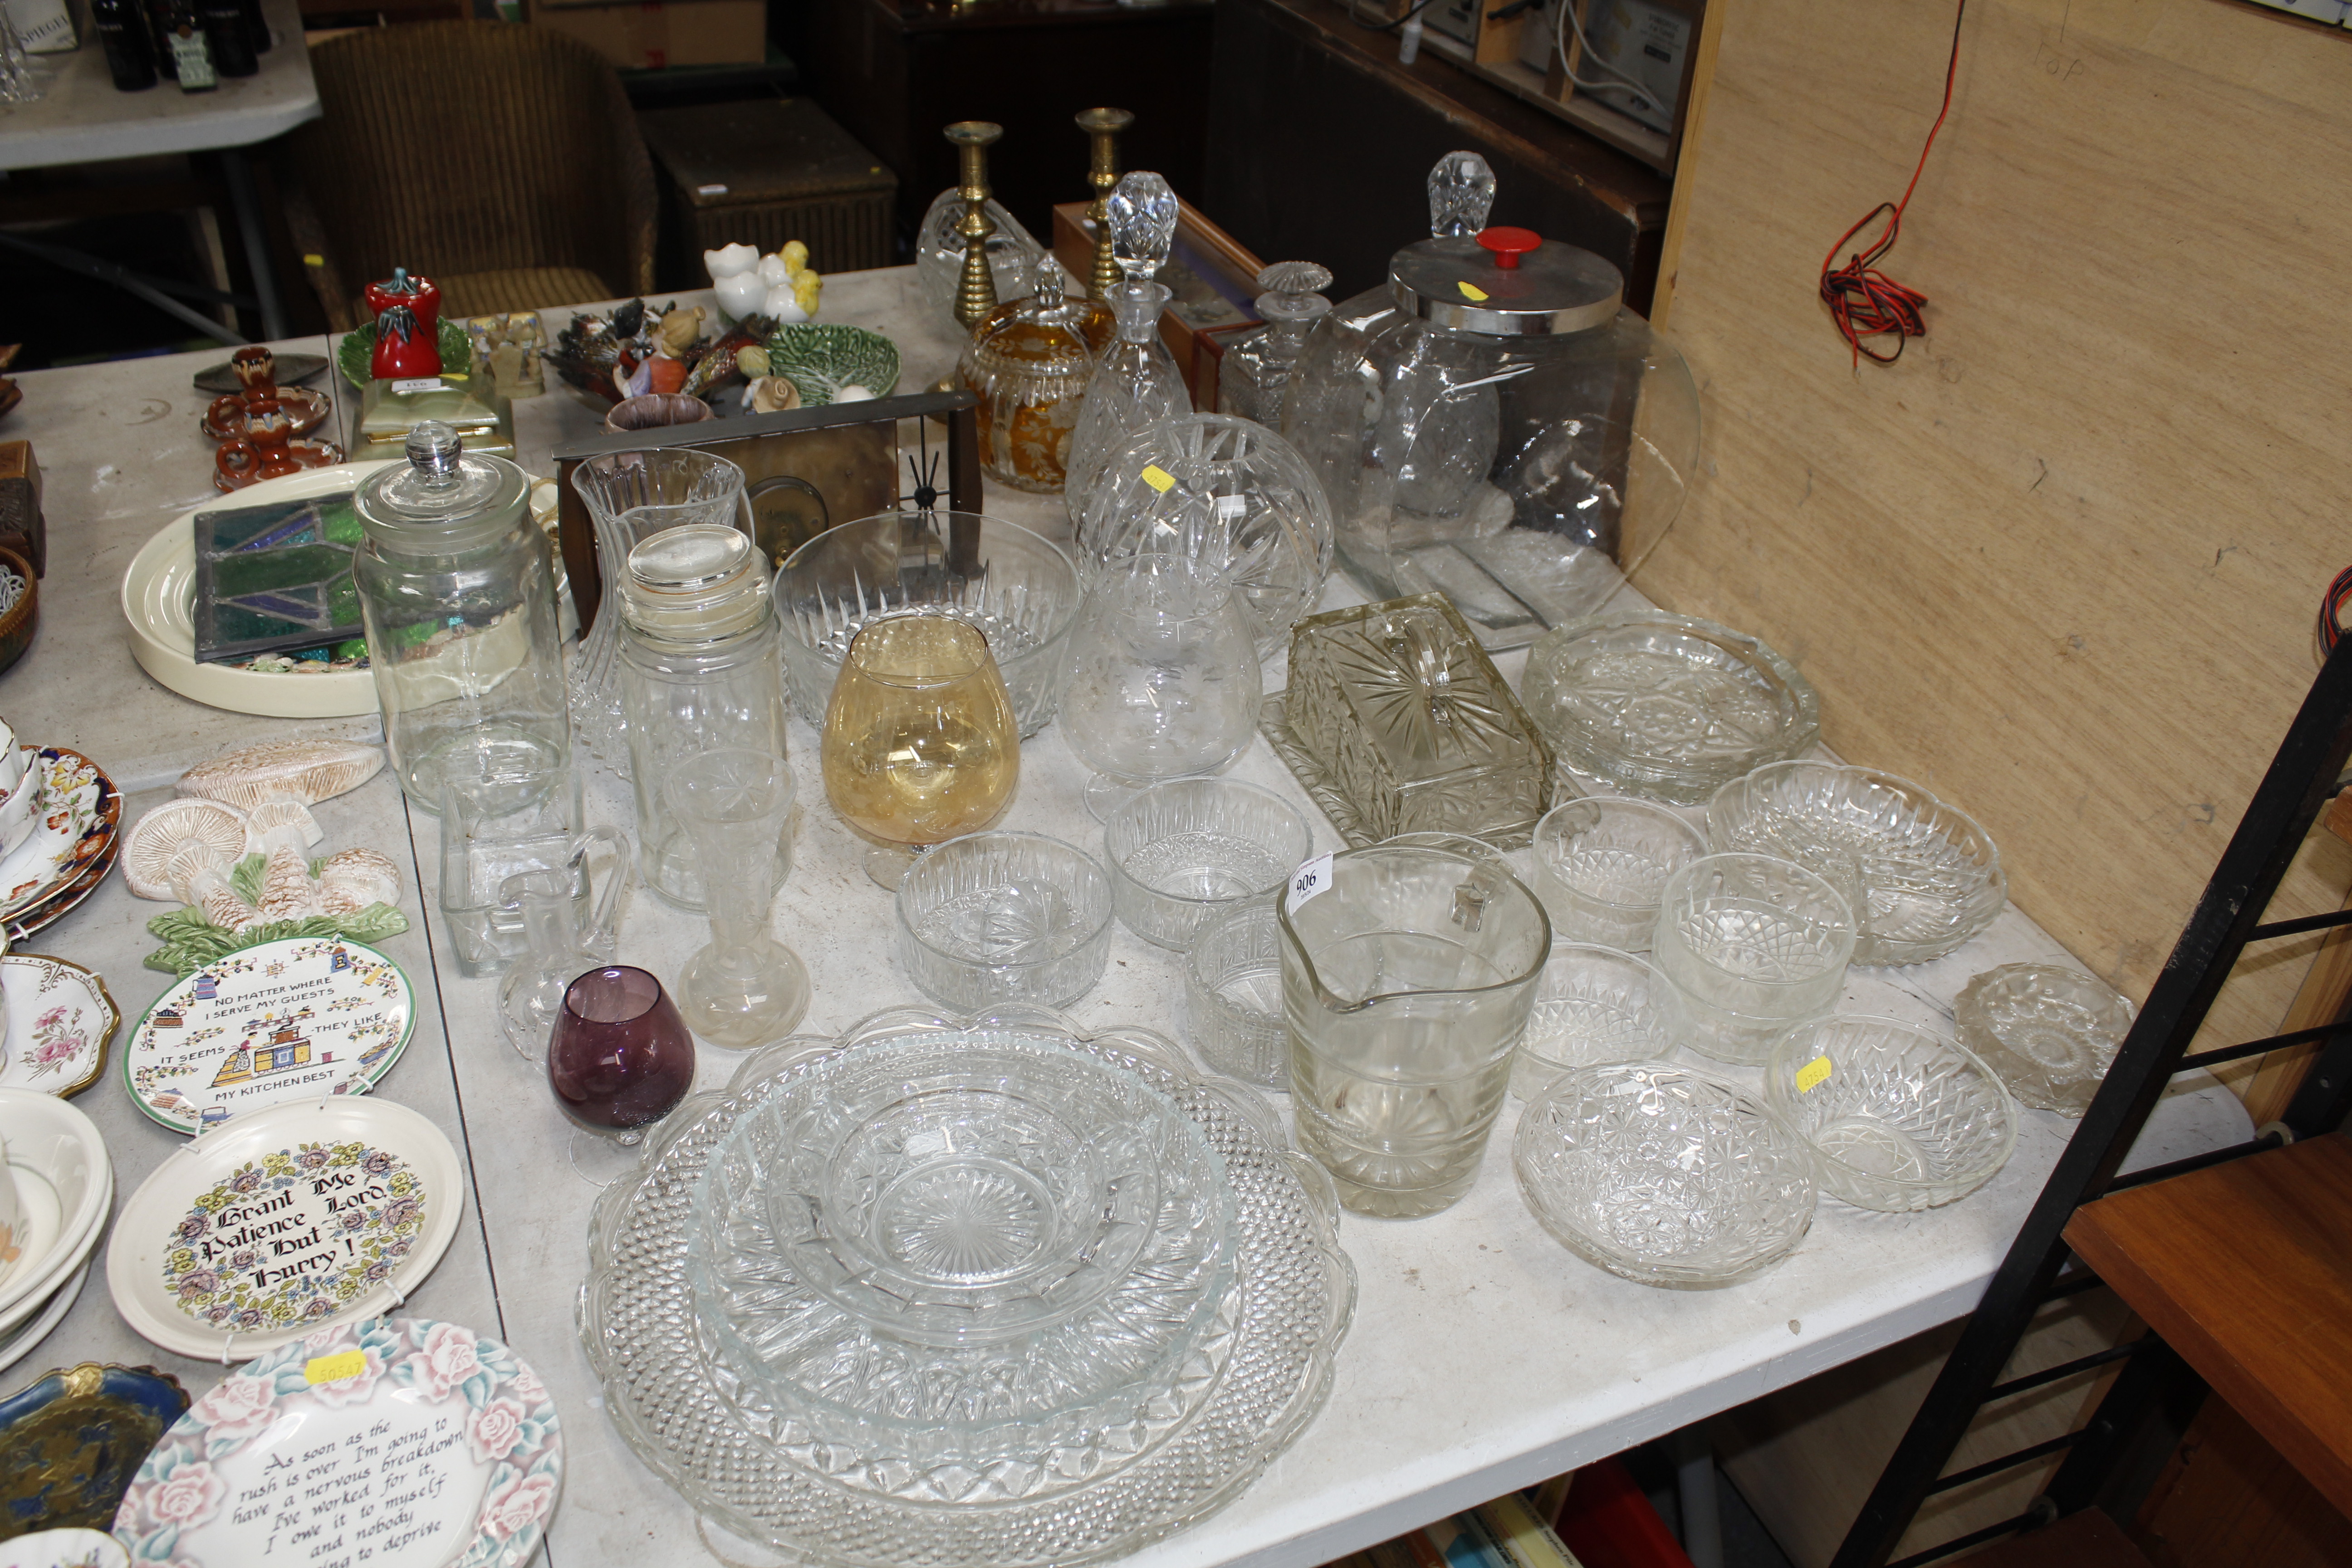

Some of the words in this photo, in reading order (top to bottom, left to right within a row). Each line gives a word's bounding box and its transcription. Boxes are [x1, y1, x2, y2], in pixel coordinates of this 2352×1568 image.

[1297, 869, 1316, 897] 906
[214, 1004, 252, 1019] SERVE
[256, 999, 277, 1009] MY
[281, 987, 335, 1004] GUESTS
[215, 997, 234, 1007] NO
[237, 986, 286, 1002] MATTER
[289, 976, 333, 991] WHERE
[354, 1012, 382, 1026] LIKE
[179, 1046, 225, 1063] SEEMS
[215, 1090, 236, 1102] MY
[240, 1077, 300, 1097] KITCHEN
[303, 1069, 336, 1083] BEST
[216, 1189, 295, 1229] Grant
[309, 1172, 356, 1196] Me
[199, 1212, 307, 1264] Patience
[267, 1226, 323, 1257] But
[319, 1362, 362, 1382] 50547
[240, 1476, 277, 1503] rush
[286, 1473, 299, 1488] is
[306, 1459, 340, 1480] over
[353, 1445, 378, 1464] I'm
[387, 1427, 428, 1455] going
[434, 1417, 447, 1433] to
[263, 1452, 294, 1476] As
[302, 1442, 336, 1462] soon
[345, 1432, 363, 1446] as
[369, 1418, 391, 1438] the
[232, 1503, 270, 1525] have
[284, 1495, 295, 1509] a
[304, 1467, 372, 1500] nervous
[380, 1430, 464, 1474] breakdown
[263, 1534, 277, 1556] I
[290, 1524, 322, 1545] owe
[333, 1513, 347, 1529] it
[360, 1504, 375, 1519] to
[384, 1472, 448, 1512] myself
[272, 1511, 301, 1532] I've
[312, 1483, 371, 1517] worked
[379, 1473, 409, 1499] for
[309, 1534, 344, 1559] and
[355, 1510, 415, 1542] nobody
[358, 1547, 373, 1562] to
[382, 1520, 442, 1553] deprive
[1543, 1530, 1563, 1555] Stephen
